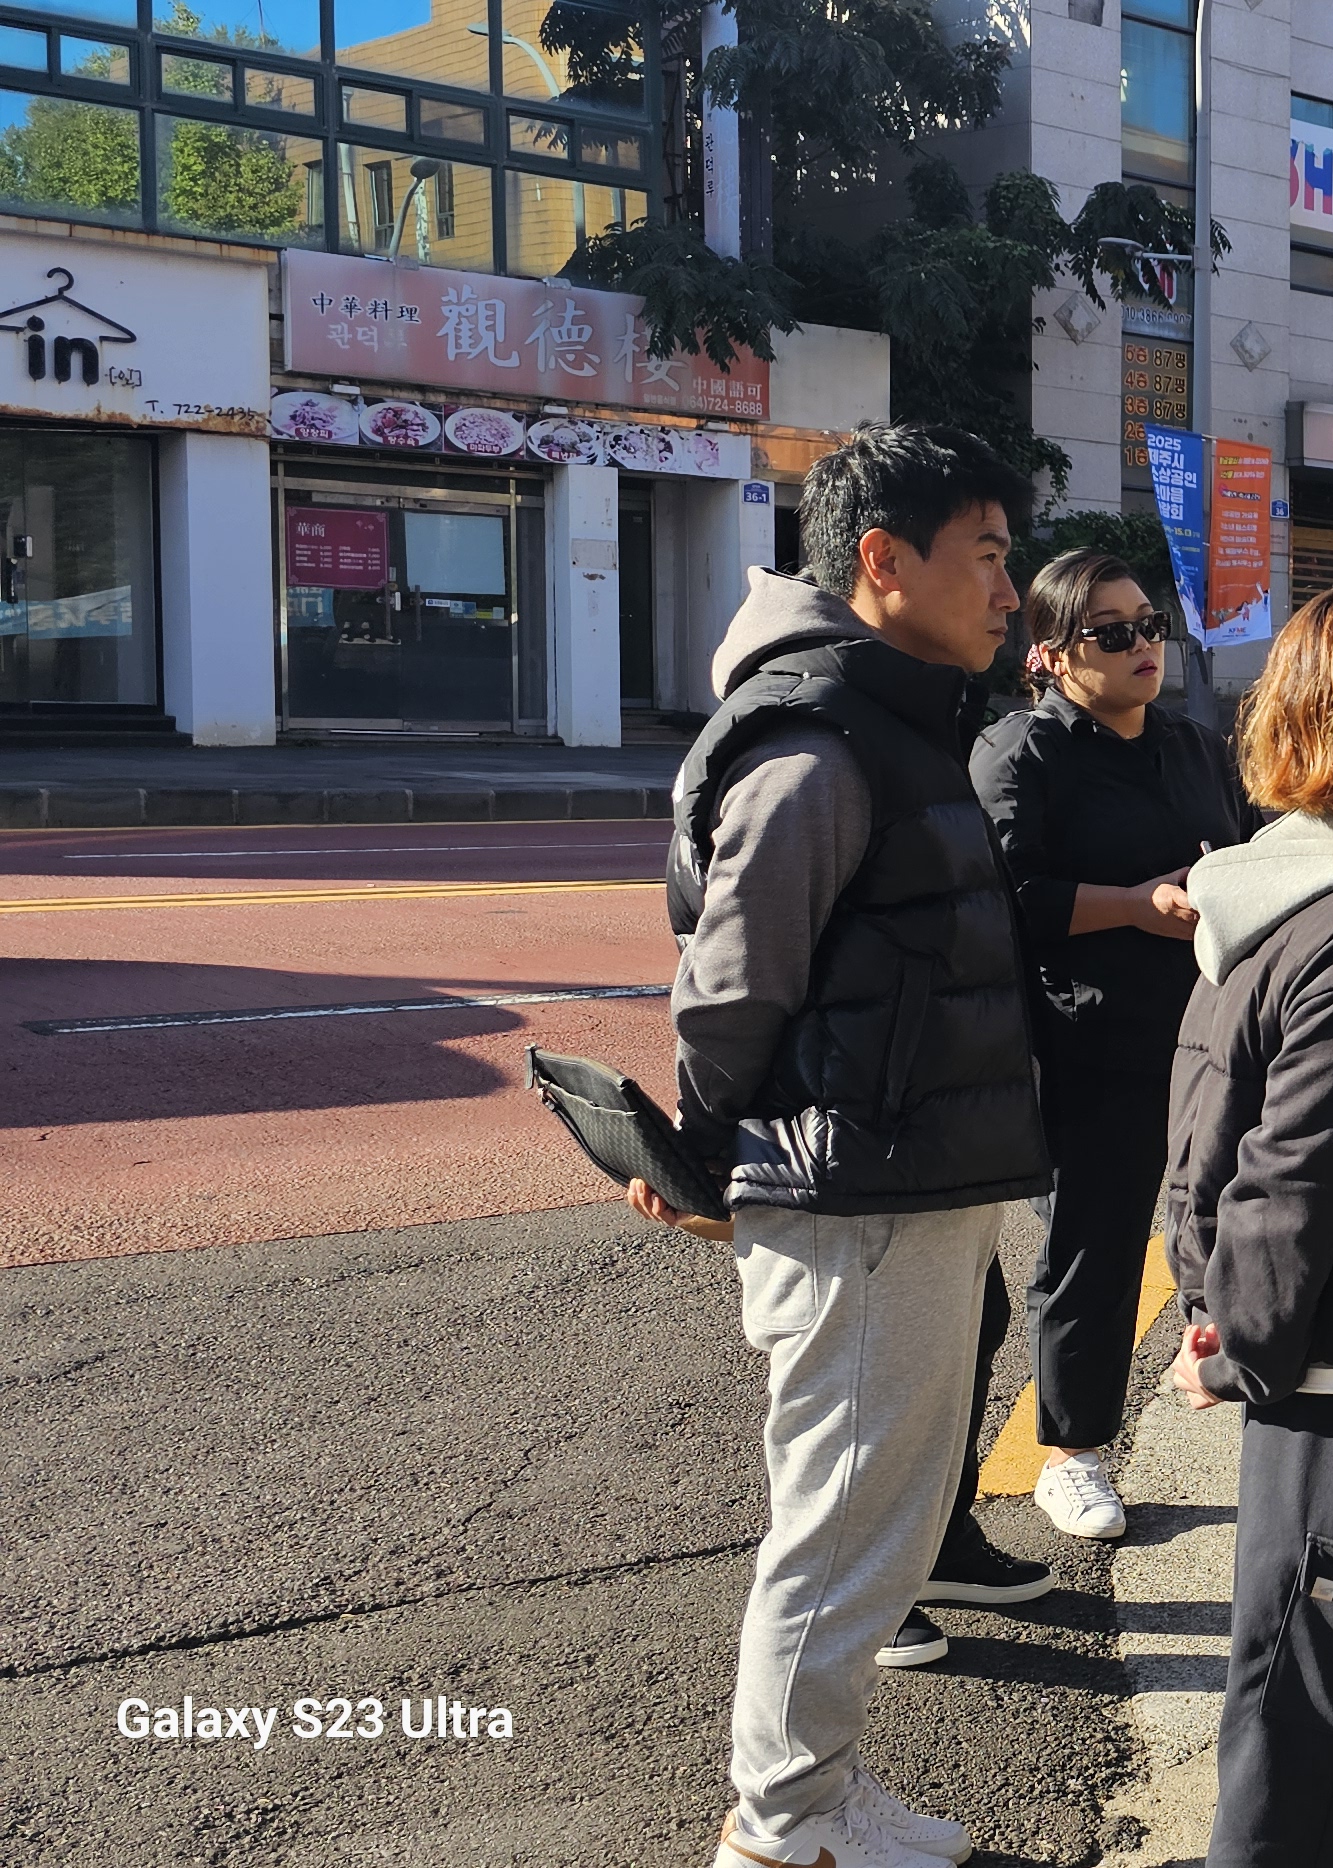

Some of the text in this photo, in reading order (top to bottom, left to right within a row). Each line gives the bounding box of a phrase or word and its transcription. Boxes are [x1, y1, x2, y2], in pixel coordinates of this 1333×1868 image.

[311, 291, 421, 325] 中華料理
[26, 315, 100, 387] in
[1124, 342, 1187, 369] 5층 87평
[1124, 369, 1187, 396] 4층 87평
[145, 400, 165, 415] T.
[1124, 396, 1187, 422] 3층 87평
[1147, 434, 1182, 451] 2025
[1148, 448, 1185, 469] 제주시
[745, 491, 767, 503] 36-1
[1158, 500, 1184, 520] 람회
[1275, 506, 1285, 516] 36
